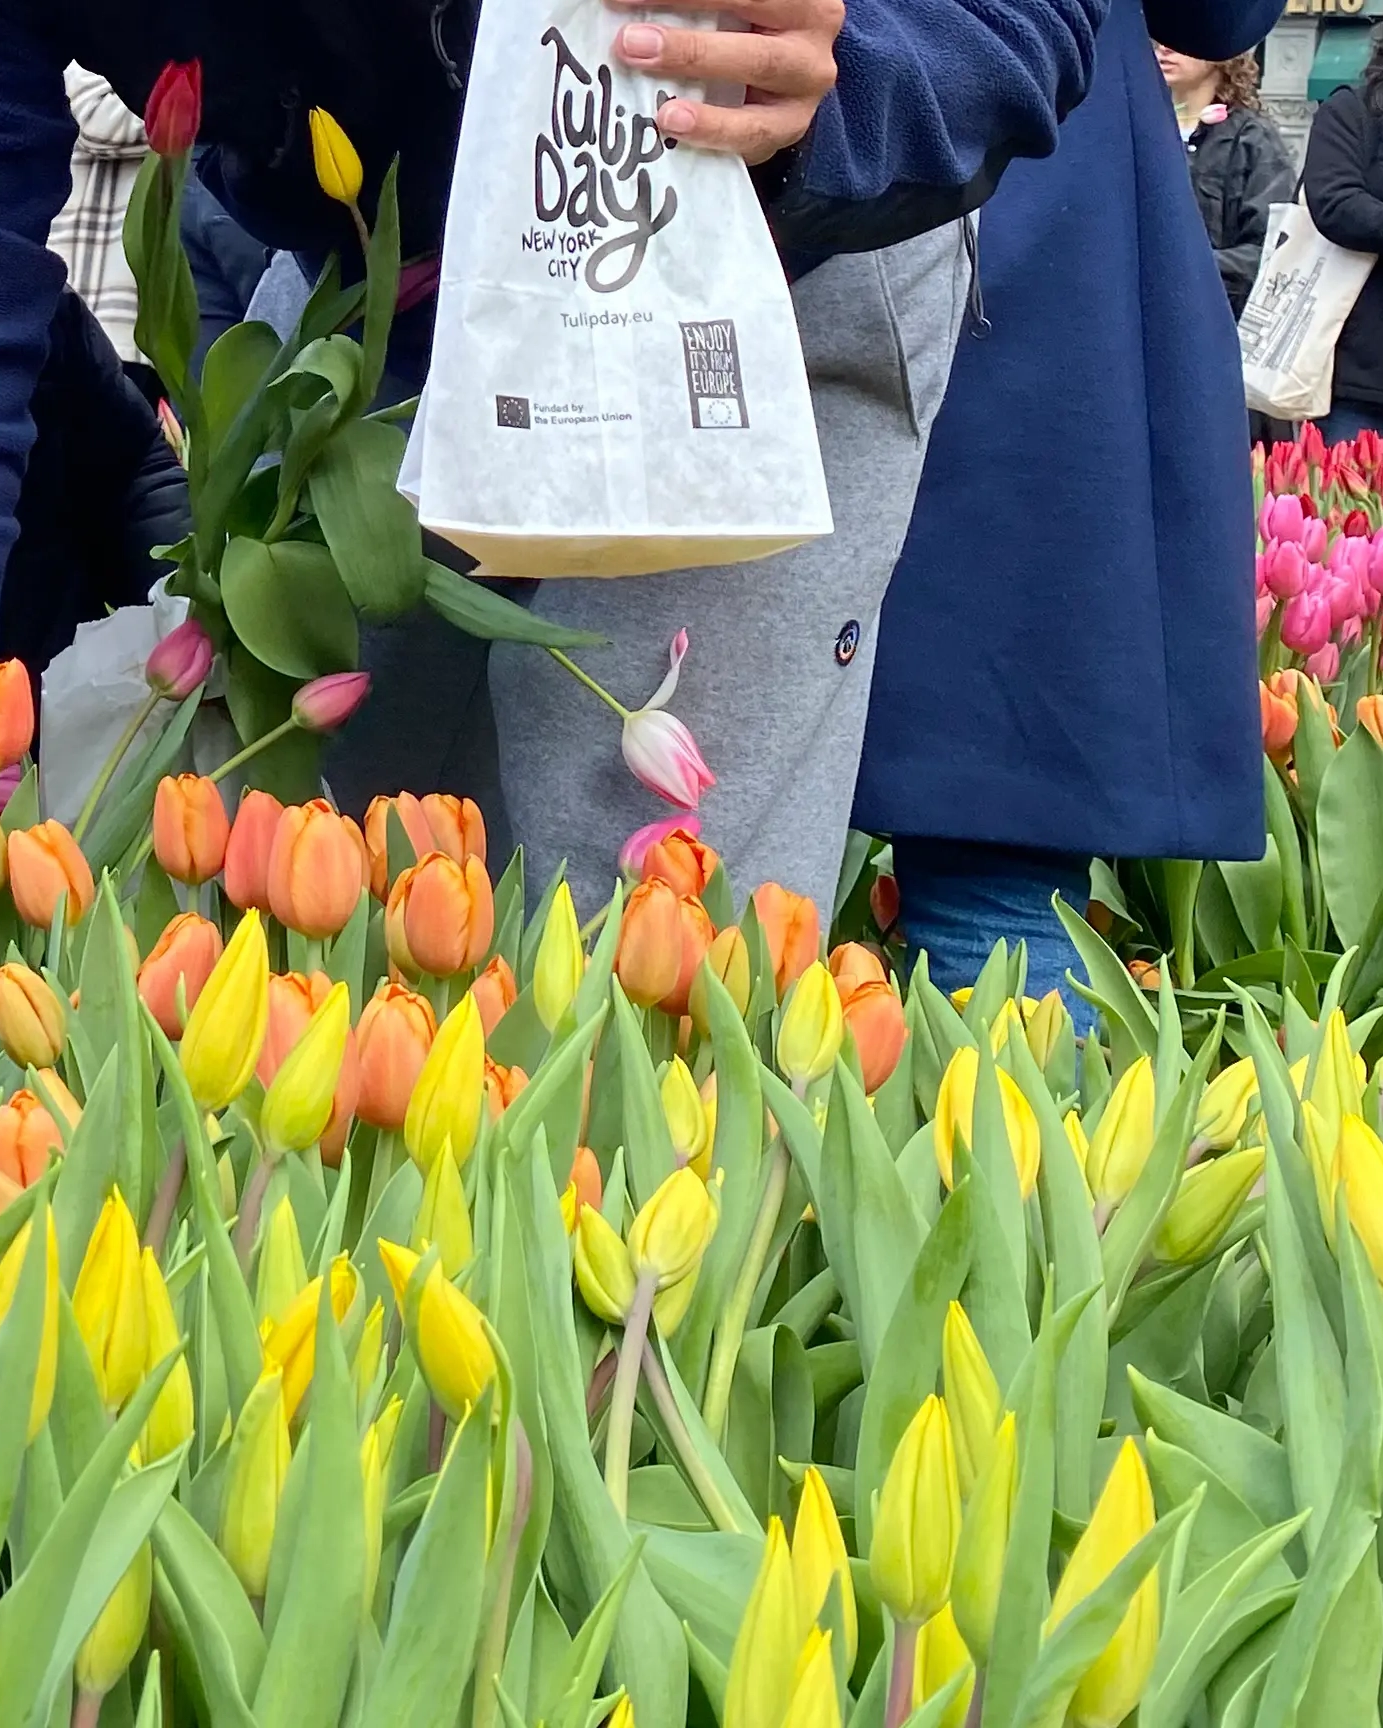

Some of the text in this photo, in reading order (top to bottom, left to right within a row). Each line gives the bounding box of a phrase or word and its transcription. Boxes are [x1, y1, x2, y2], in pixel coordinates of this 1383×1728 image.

[541, 26, 665, 181] Tulip
[535, 132, 678, 293] Day
[522, 226, 603, 255] NEW YORK
[548, 256, 581, 281] CITY
[560, 310, 653, 328] Tulipday.eu
[683, 324, 731, 351] ENJOY
[691, 370, 737, 395] EUROPE
[533, 403, 584, 414] Funded by
[534, 412, 632, 425] the European Union
